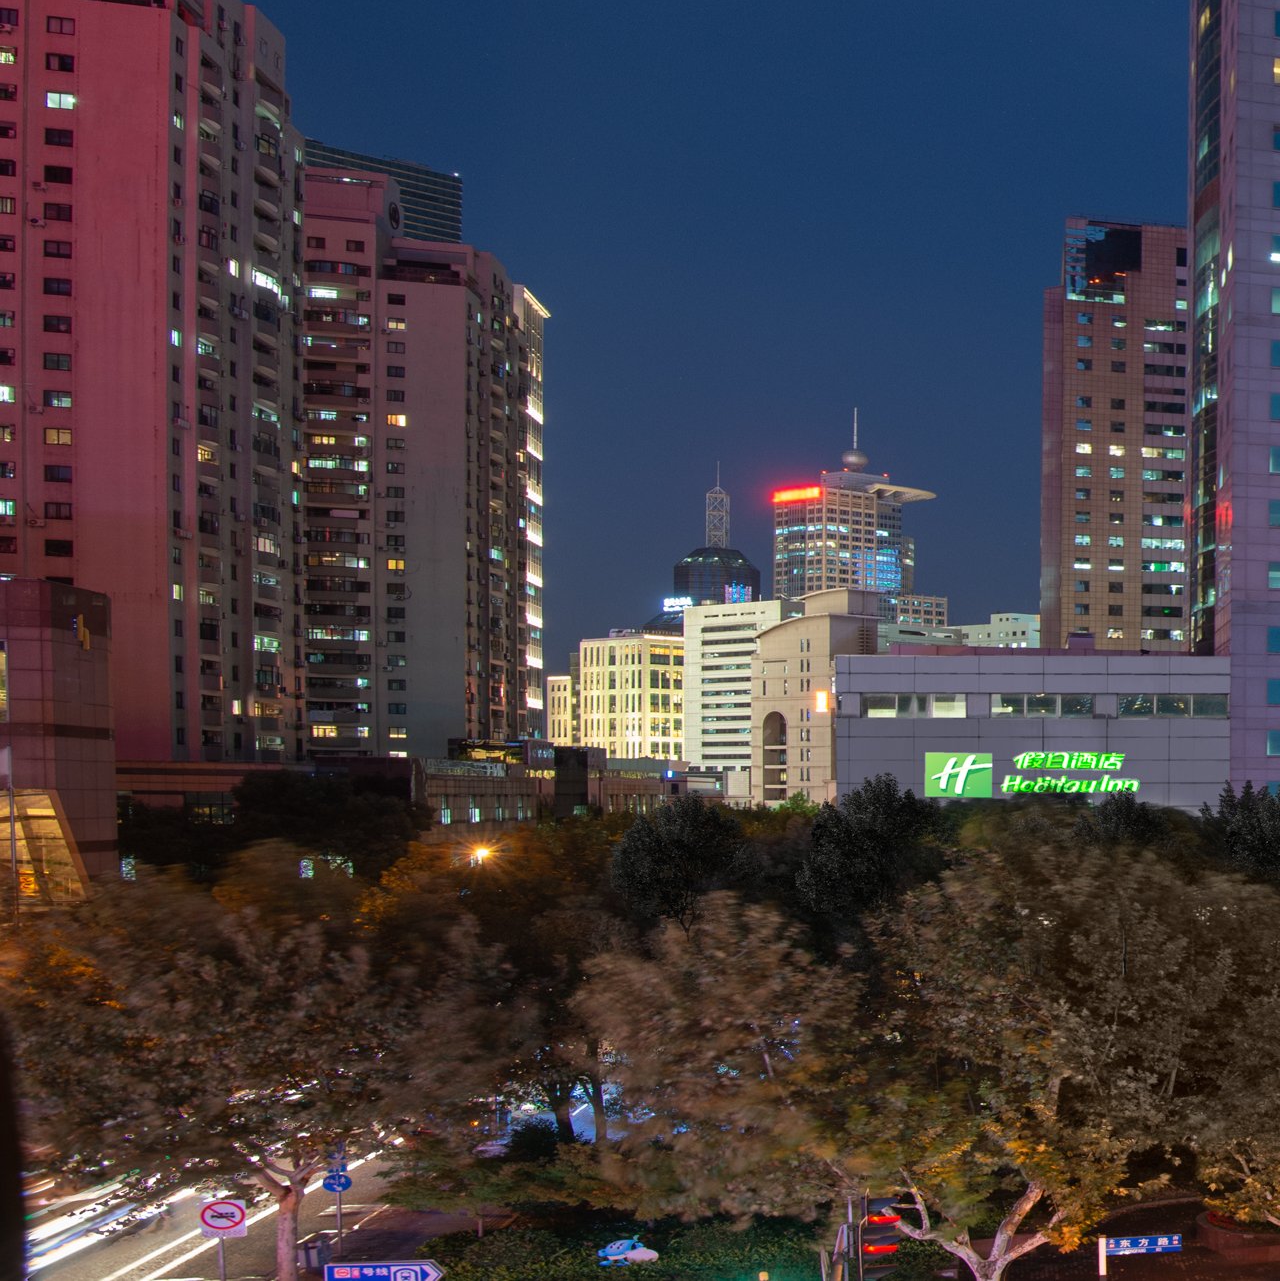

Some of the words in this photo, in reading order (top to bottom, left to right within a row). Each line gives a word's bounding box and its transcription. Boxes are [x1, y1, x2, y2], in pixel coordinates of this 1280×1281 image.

[1013, 751, 1127, 770] 假日酒店
[1099, 774, 1140, 793] Inn
[1119, 1238, 1169, 1248] 东方路
